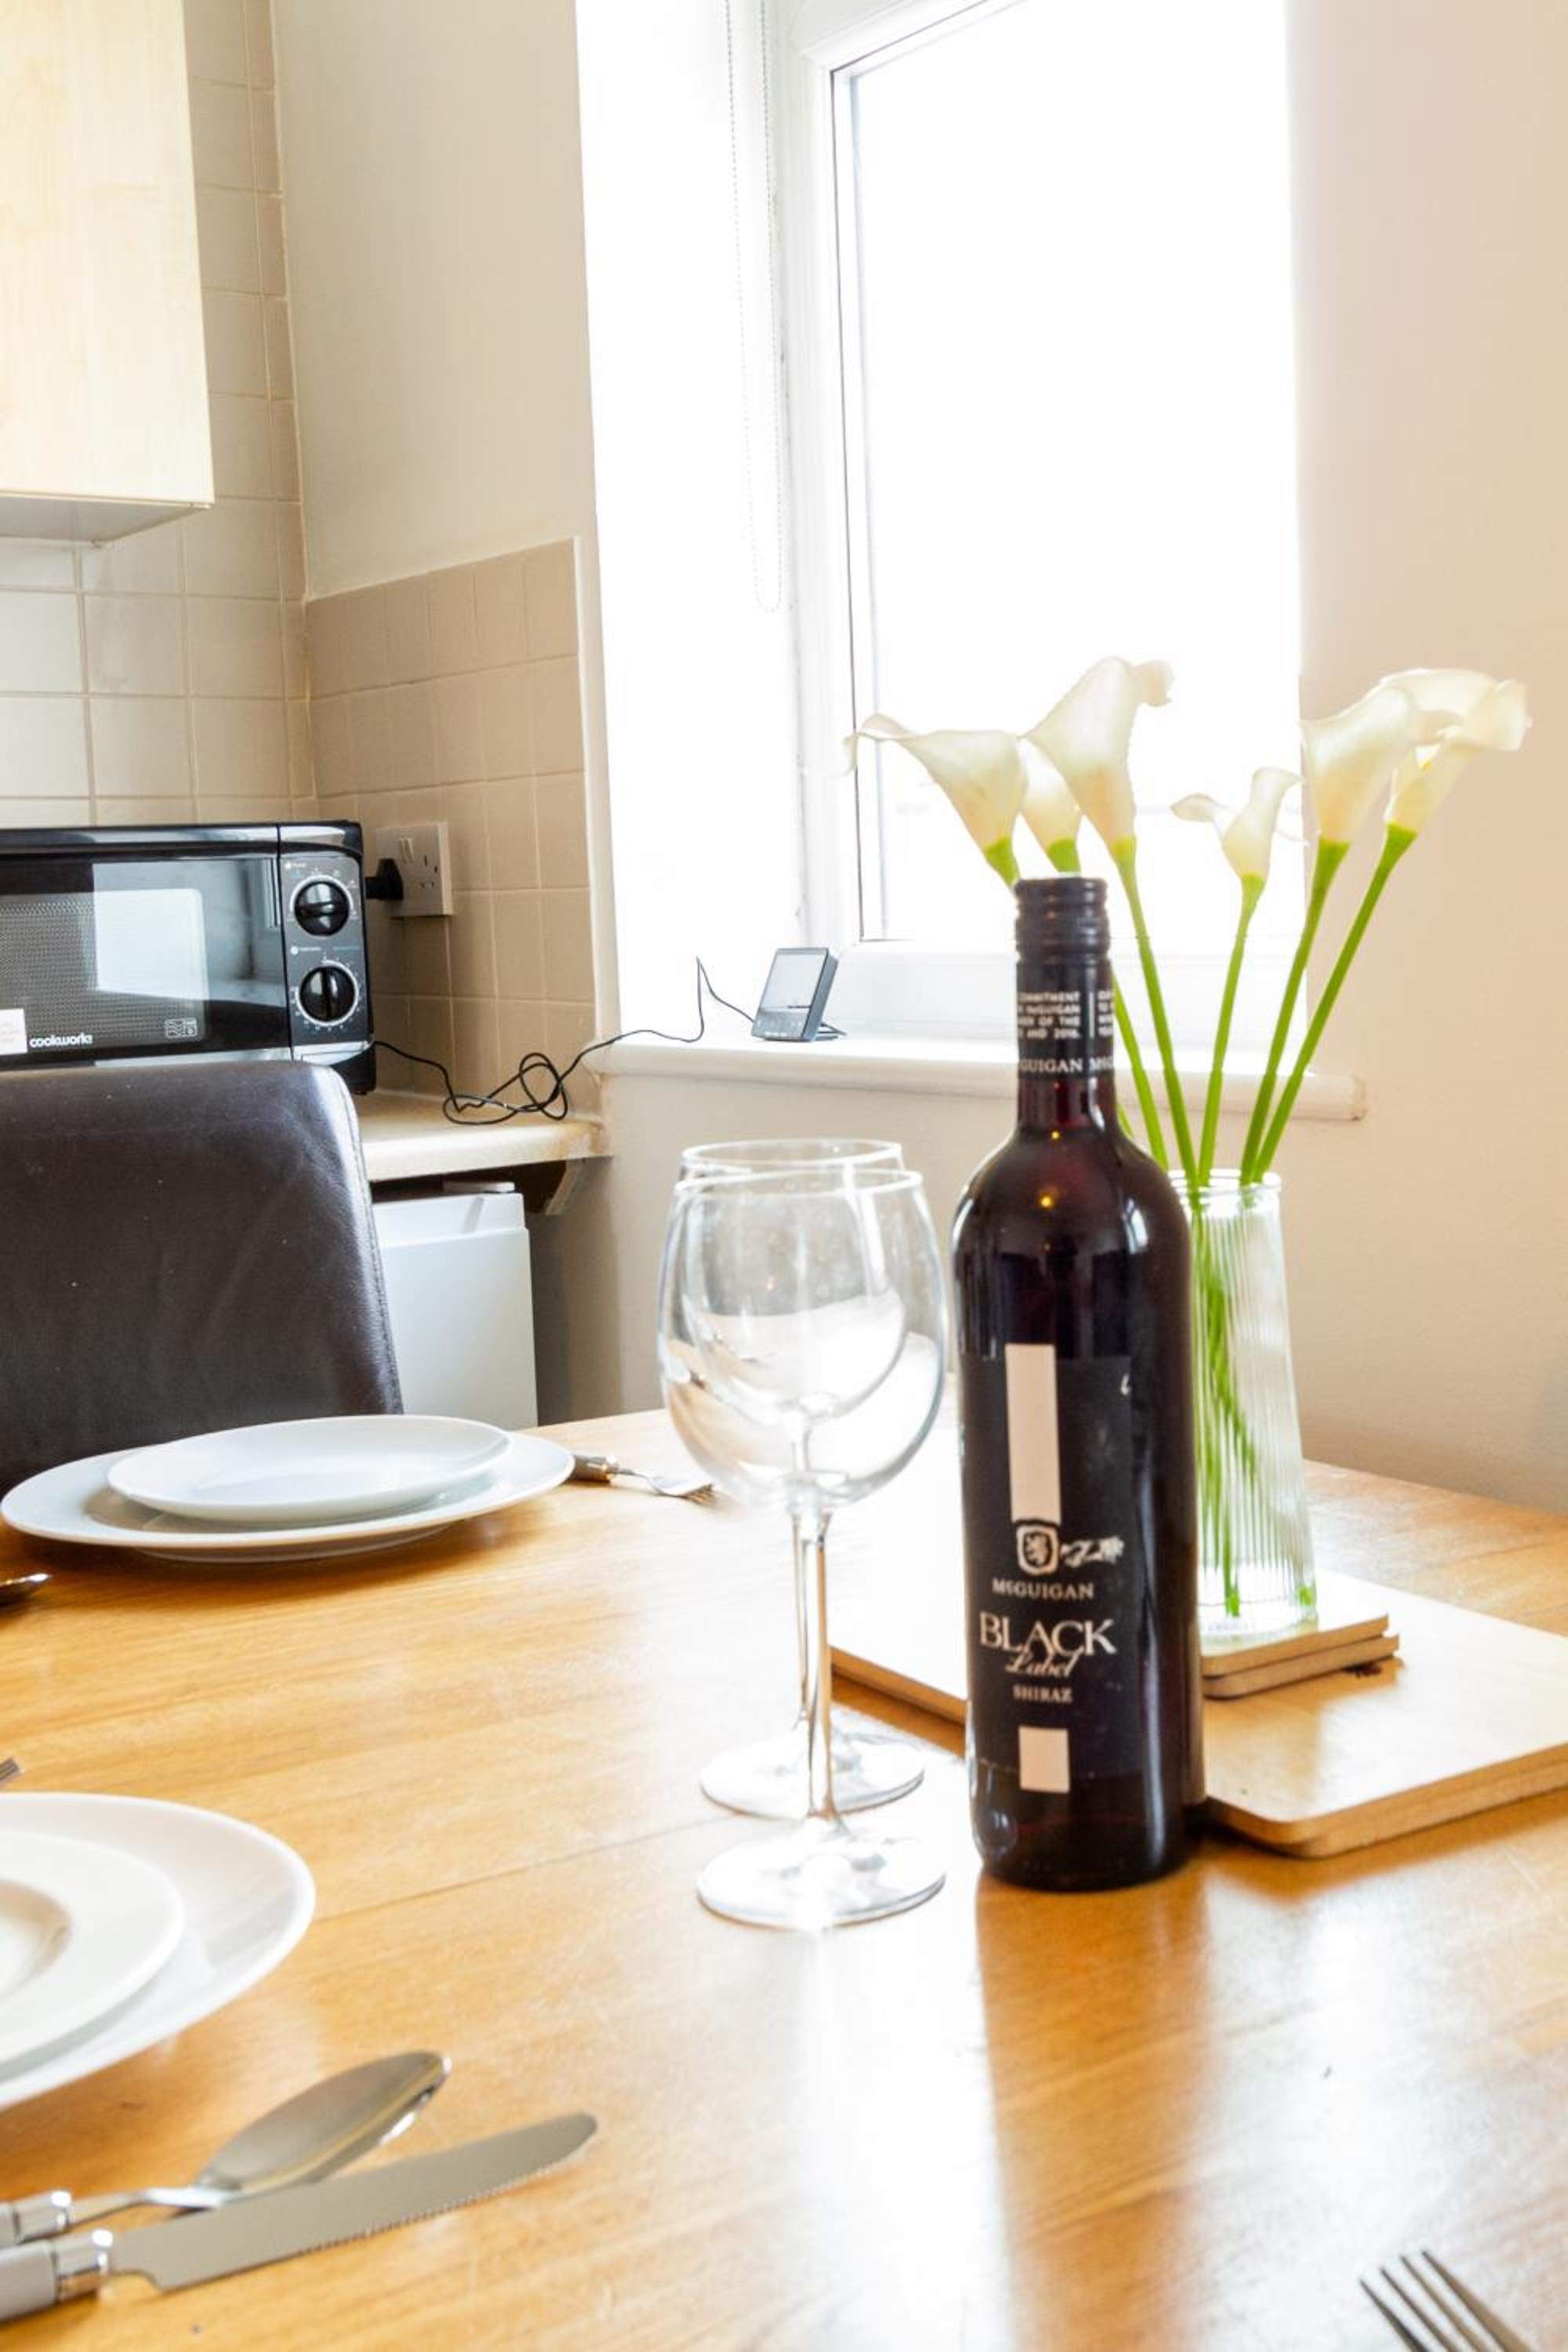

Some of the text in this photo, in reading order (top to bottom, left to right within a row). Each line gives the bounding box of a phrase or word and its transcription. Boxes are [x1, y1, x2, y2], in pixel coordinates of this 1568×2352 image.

[980, 1610, 1117, 1656] BLACK
[1005, 1645, 1085, 1677] Label
[1014, 1685, 1073, 1703] SHIRAZ
